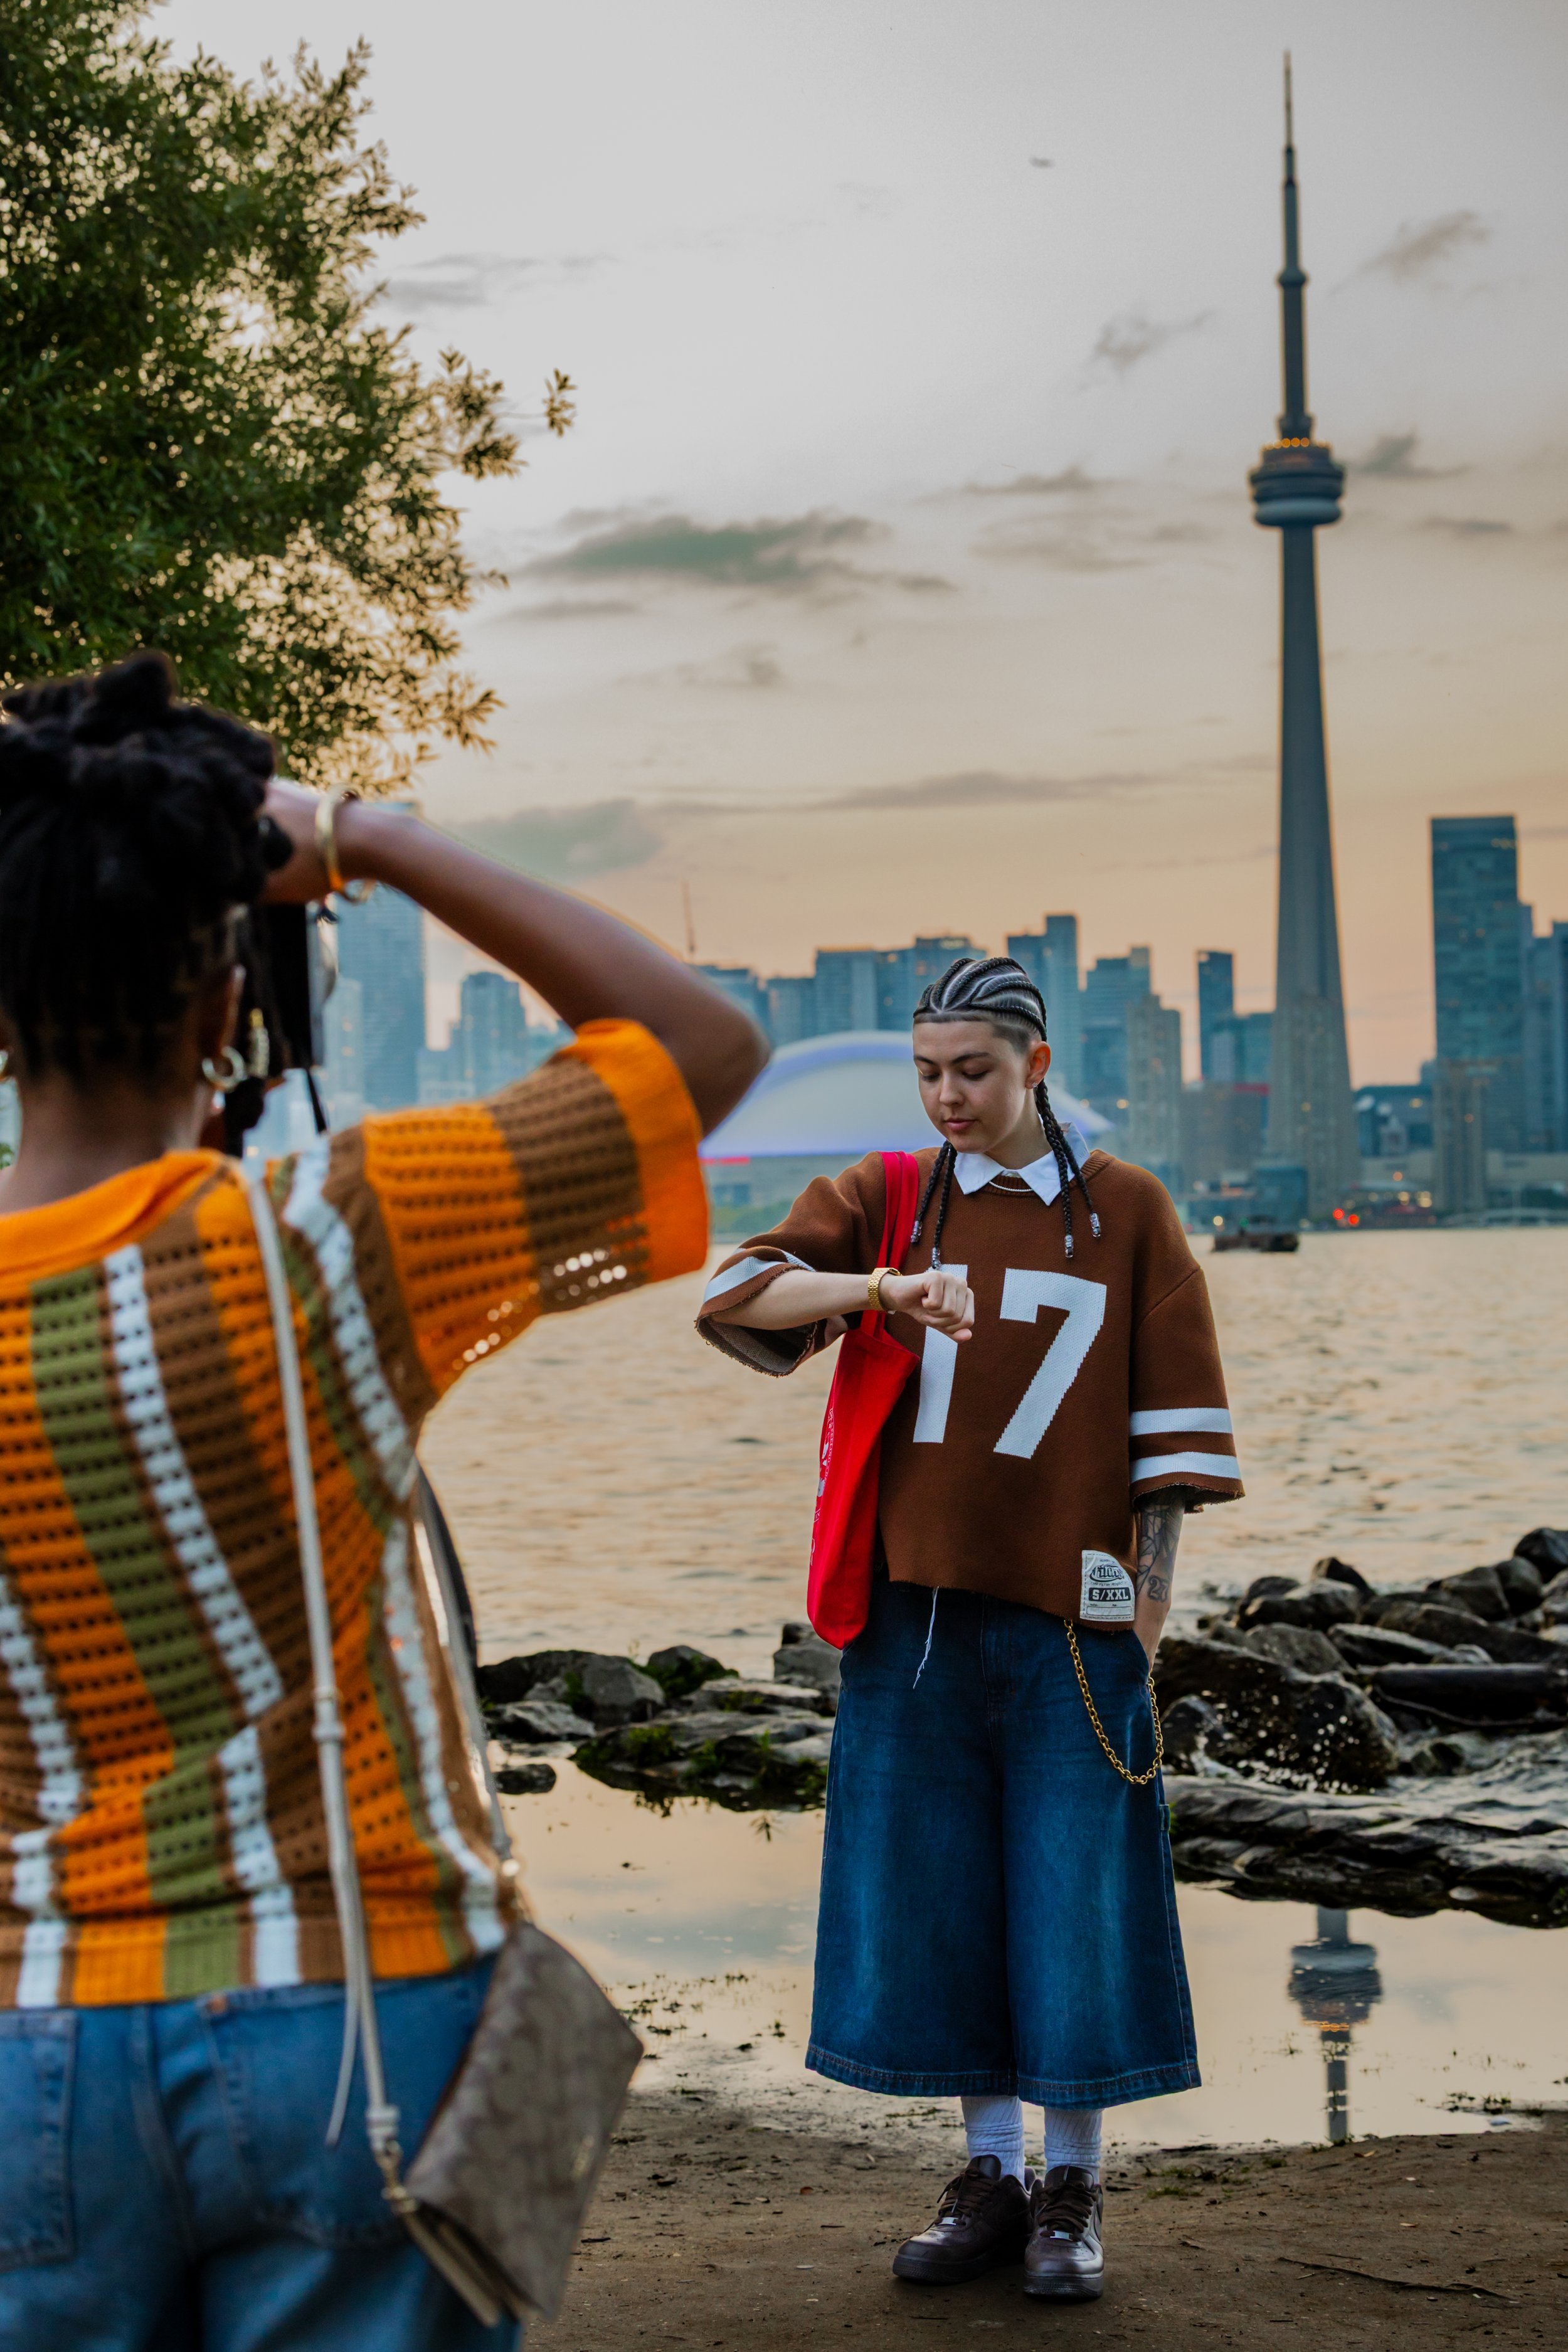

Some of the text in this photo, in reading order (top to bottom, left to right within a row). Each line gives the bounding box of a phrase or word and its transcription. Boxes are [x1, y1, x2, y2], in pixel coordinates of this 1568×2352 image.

[913, 1264, 1107, 1459] 17
[1092, 1589, 1128, 1600] S/XXL
[1148, 1576, 1170, 1602] 27
